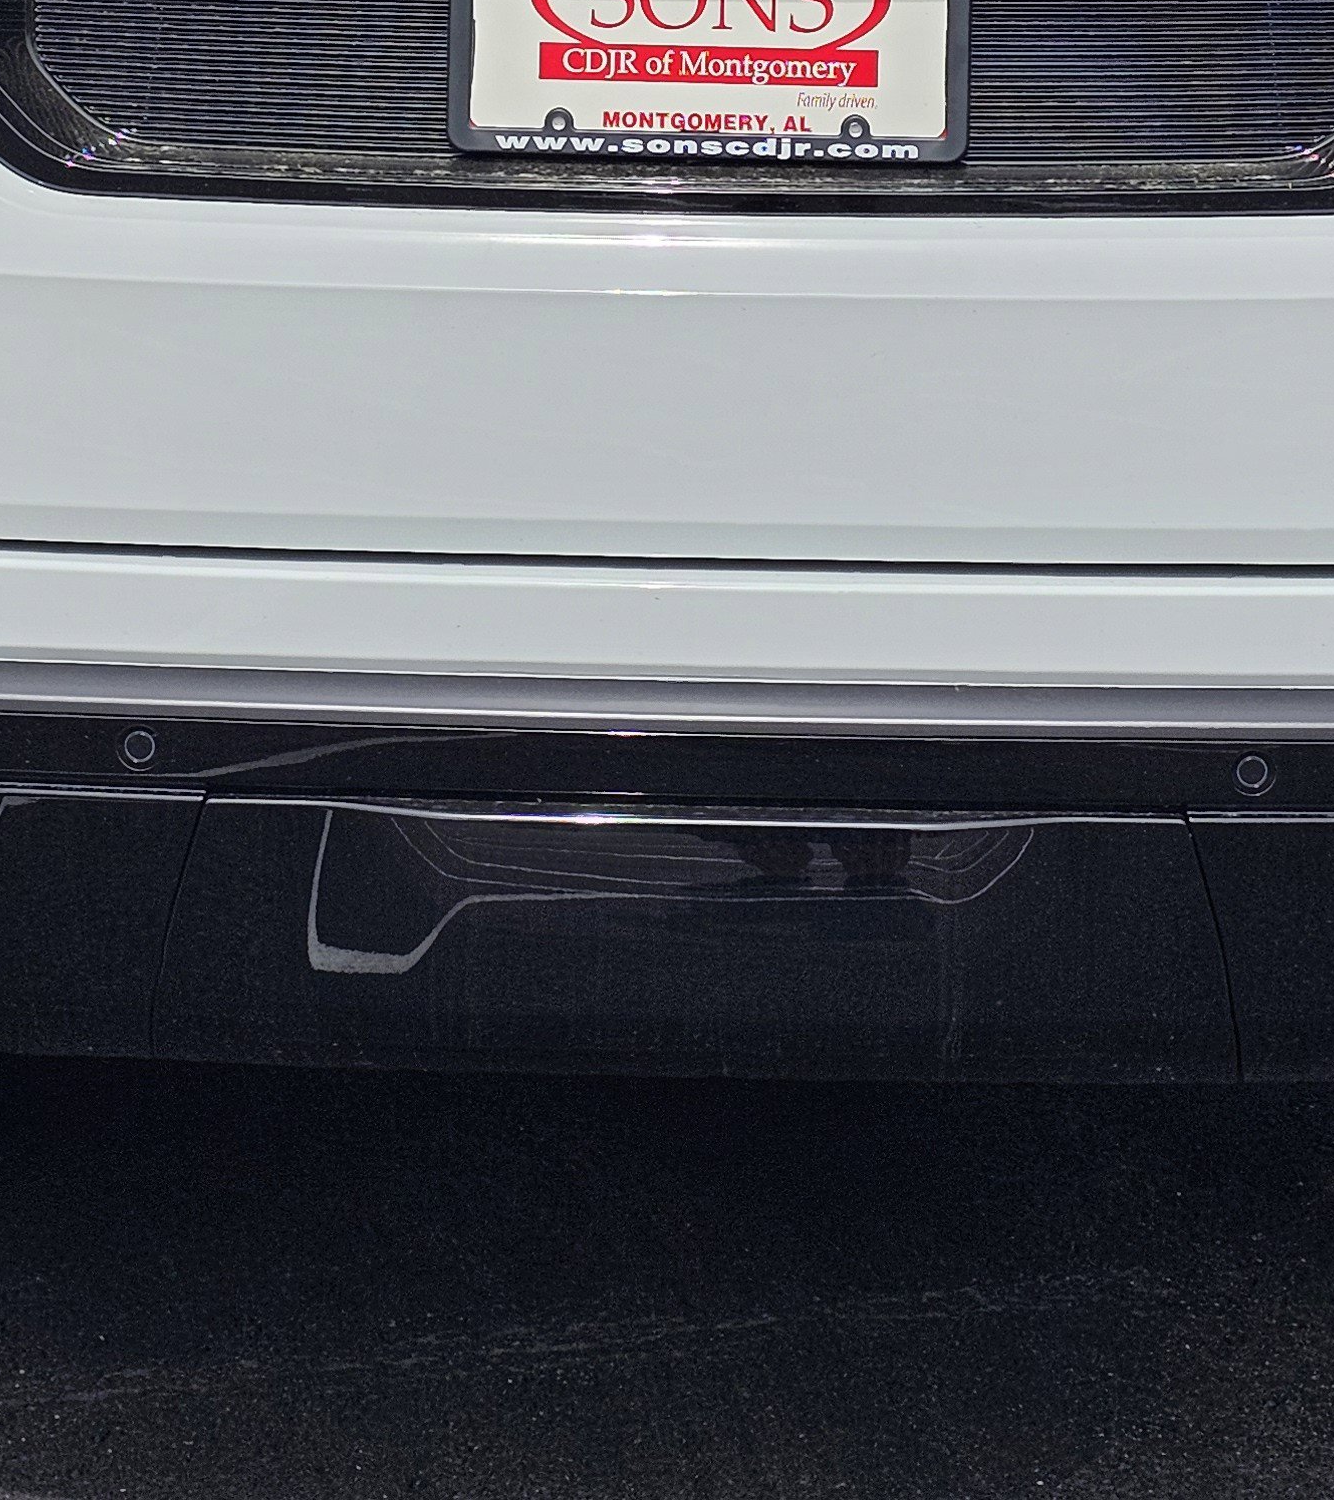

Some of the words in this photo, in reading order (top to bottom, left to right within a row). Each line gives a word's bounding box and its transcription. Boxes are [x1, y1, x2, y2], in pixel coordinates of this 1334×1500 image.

[562, 47, 638, 79] CDJR
[645, 49, 675, 75] of
[679, 50, 857, 86] Montgomery
[796, 92, 837, 111] Family
[602, 111, 775, 135] MONTGOMERY,
[783, 115, 812, 133] AL
[495, 134, 920, 160] www.sonscdjr.com
